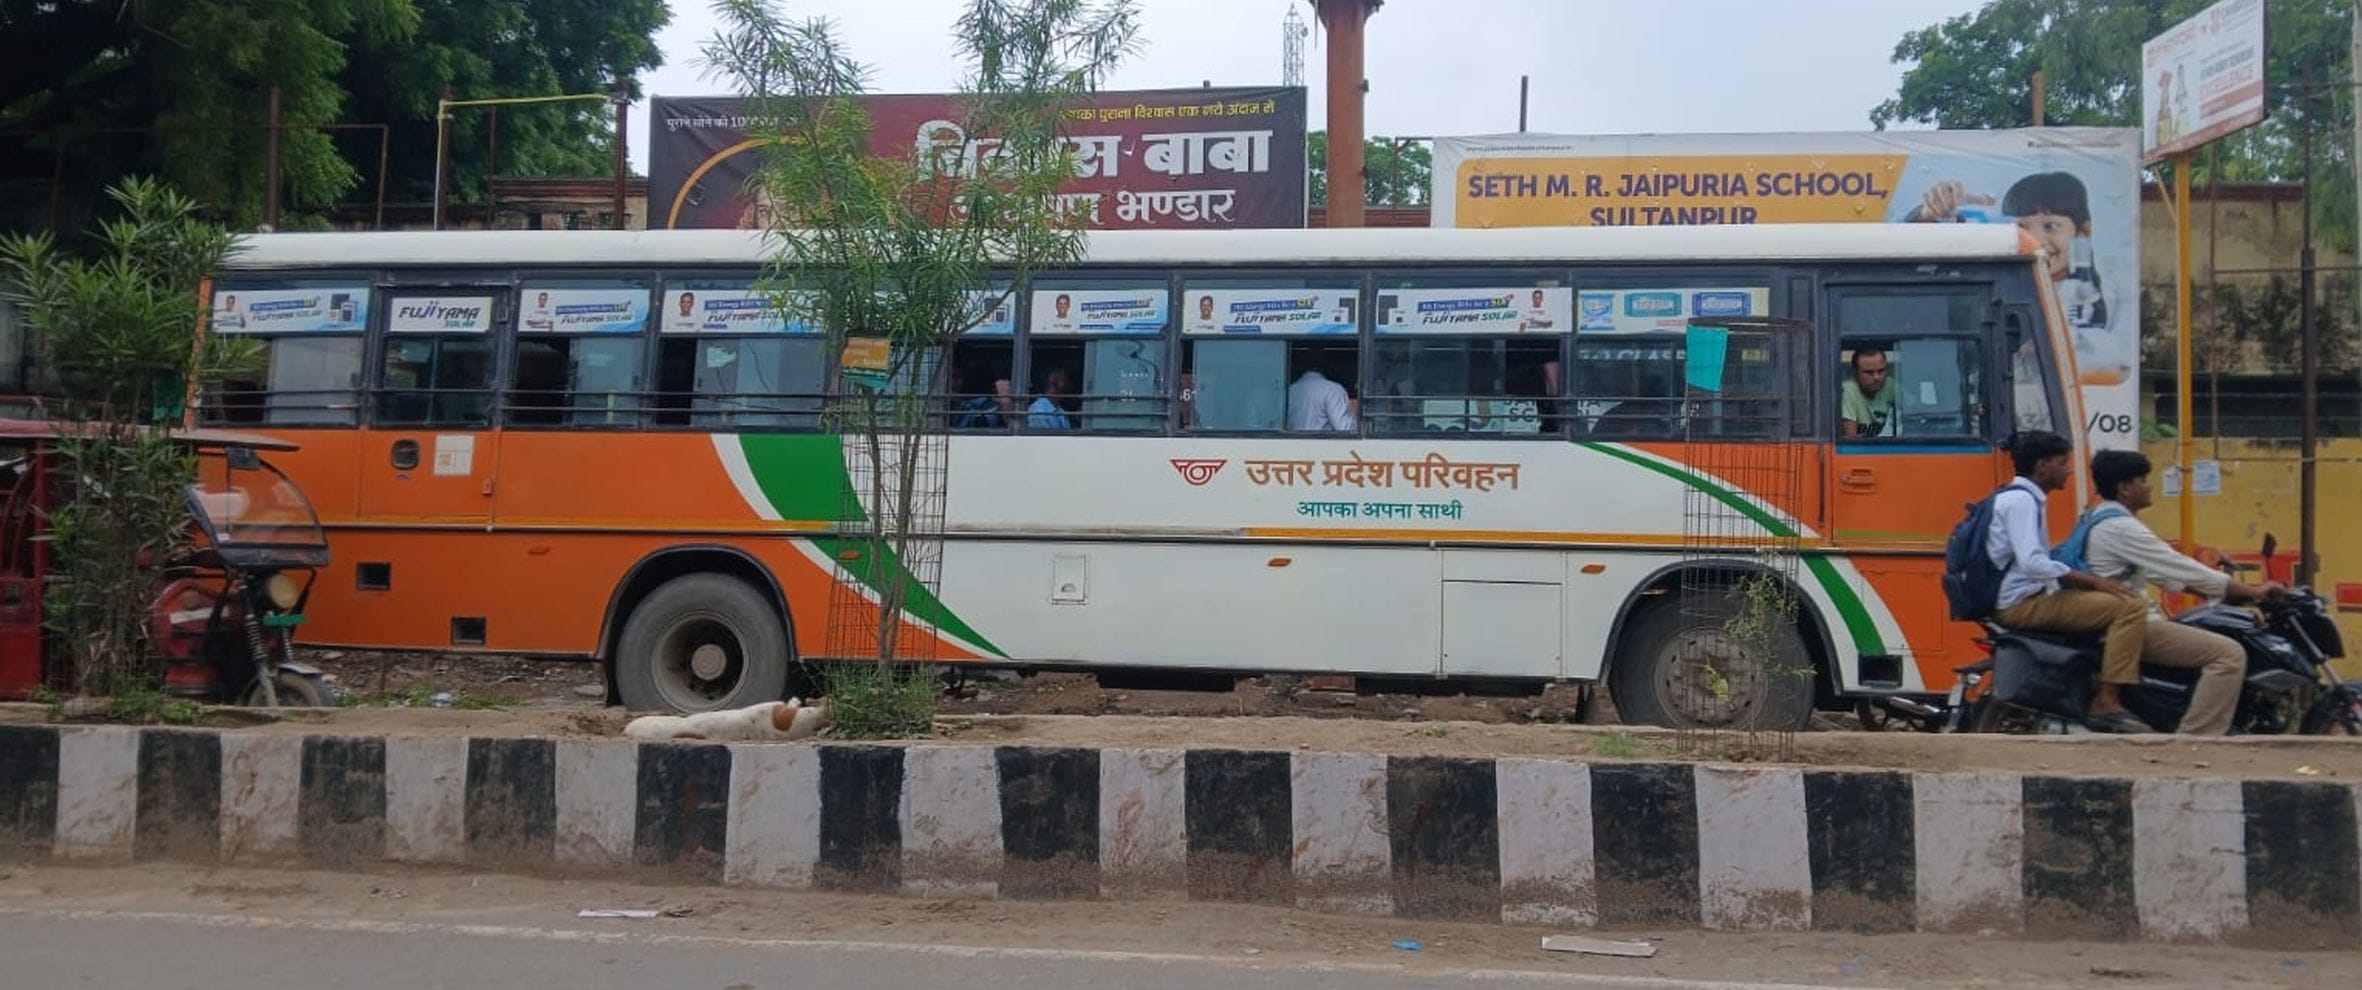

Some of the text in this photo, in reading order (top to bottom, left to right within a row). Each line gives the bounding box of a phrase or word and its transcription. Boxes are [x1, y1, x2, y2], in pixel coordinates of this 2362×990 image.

[1142, 130, 1274, 176] बाबा
[1468, 171, 1888, 200] SETH M. R. JAIPURIA SCHOOL,
[1116, 188, 1236, 223] भण्डार
[399, 300, 480, 320] FUJIYAMA
[1244, 450, 1521, 491] उत्तर प्रदेश परिवहन
[1296, 499, 1464, 520] आपका अपना साथी
